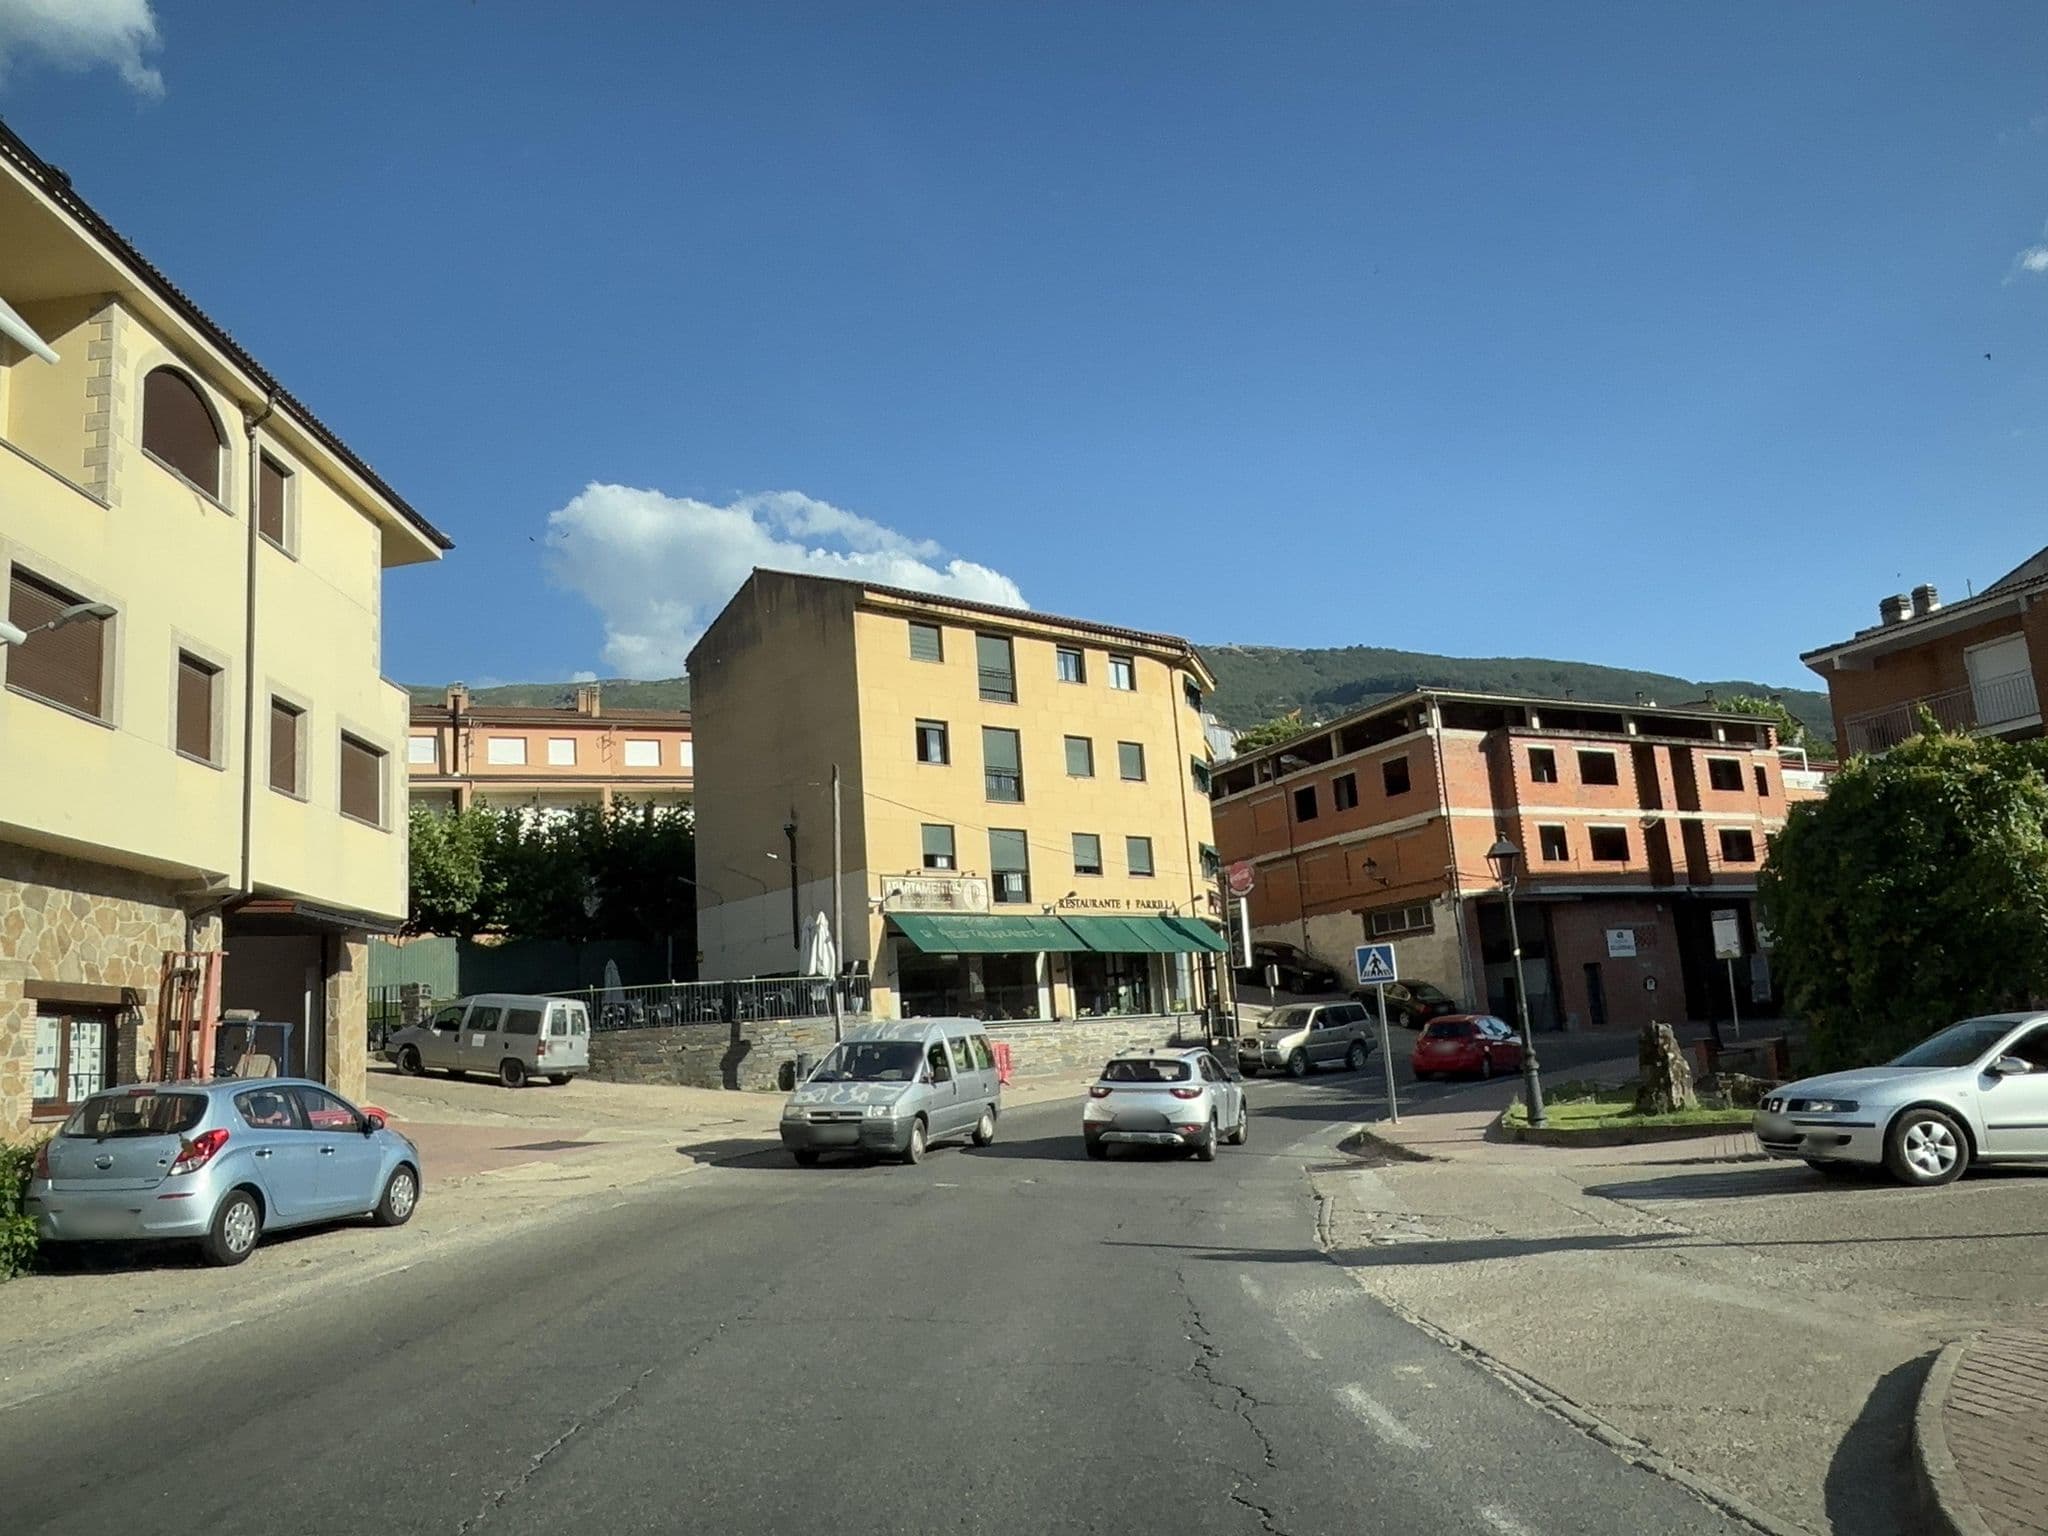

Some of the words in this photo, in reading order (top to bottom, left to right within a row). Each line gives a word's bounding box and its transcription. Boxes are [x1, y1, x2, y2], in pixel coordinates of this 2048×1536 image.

[886, 880, 961, 895] APARTAMENTOS
[1058, 898, 1121, 909] RESTAURANTE
[1136, 899, 1177, 911] PARRILLA
